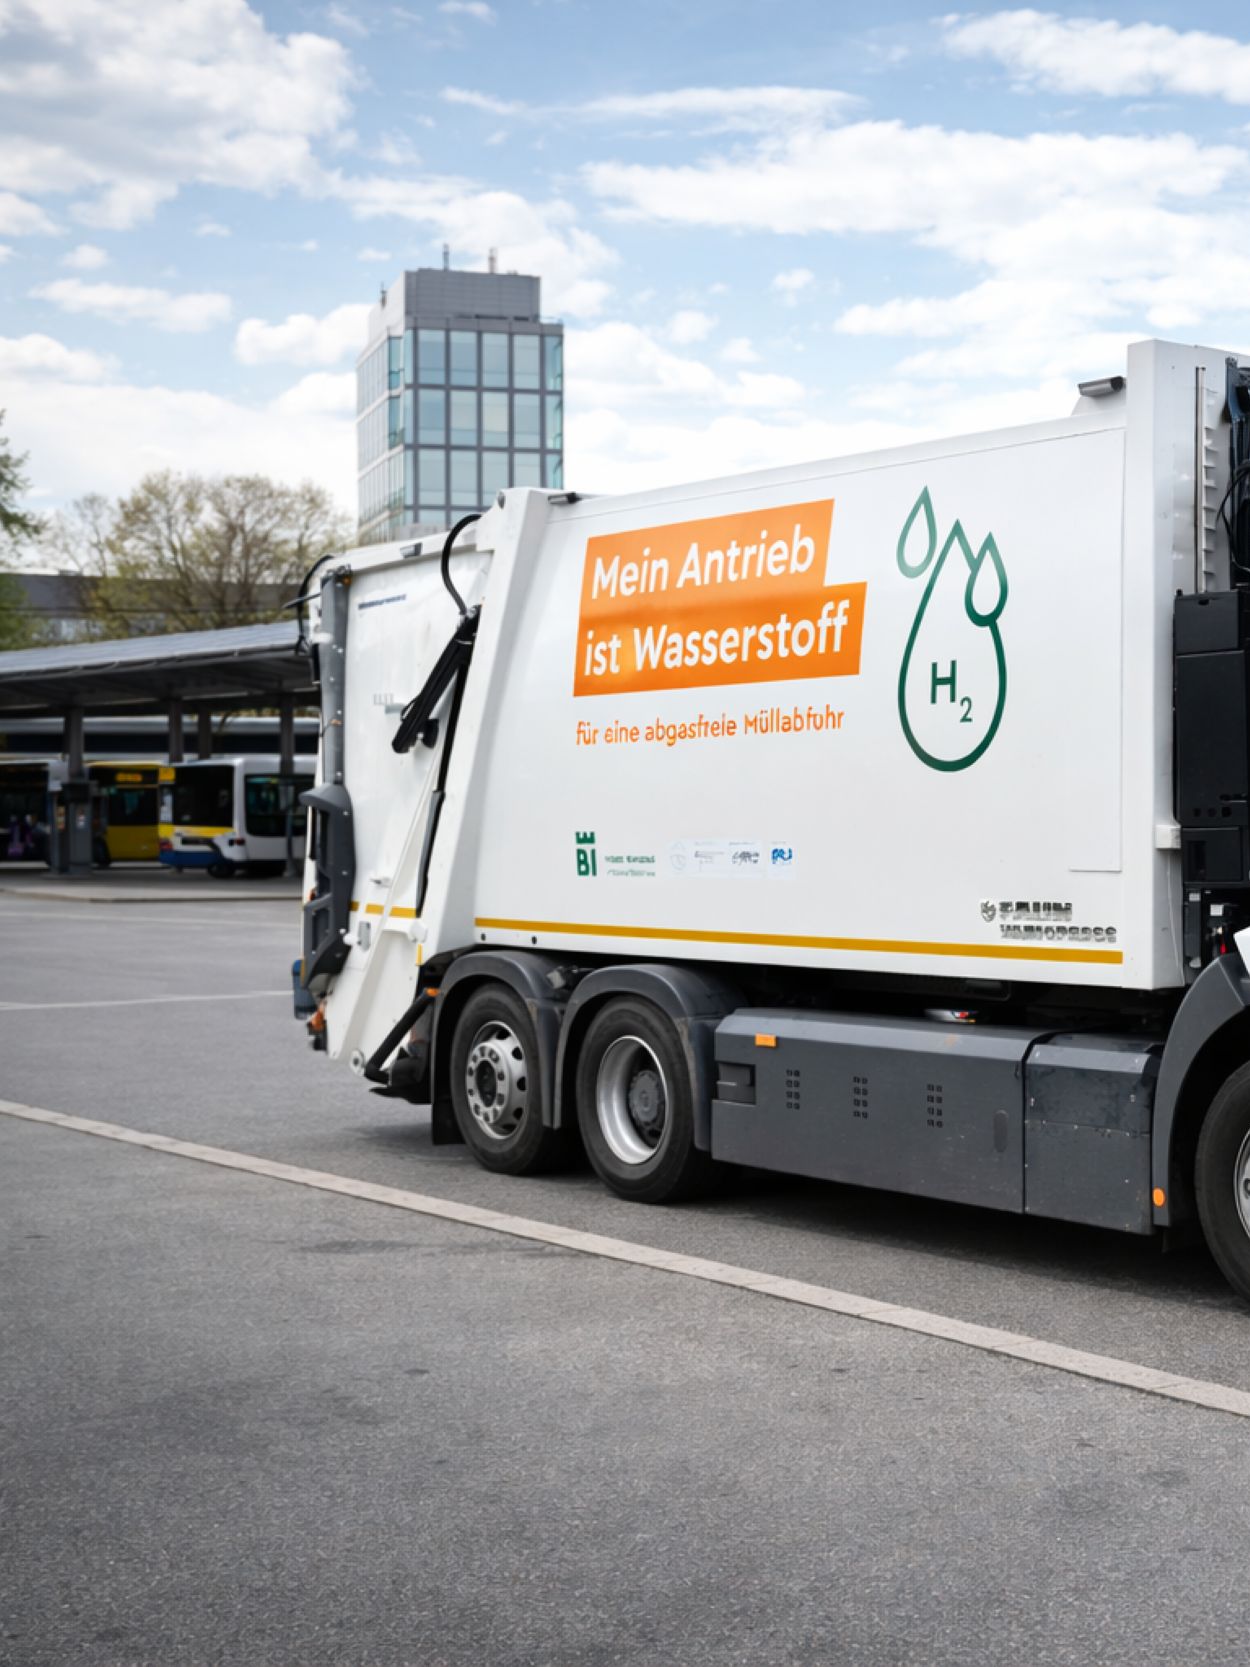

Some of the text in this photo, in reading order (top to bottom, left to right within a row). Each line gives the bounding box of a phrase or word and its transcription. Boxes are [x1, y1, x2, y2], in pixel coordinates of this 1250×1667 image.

[592, 523, 815, 600] Mein Antrieb
[584, 599, 850, 676] ist Wasserstoff
[576, 720, 599, 745] für
[604, 719, 640, 743] eine
[645, 713, 737, 747] abgasfreie
